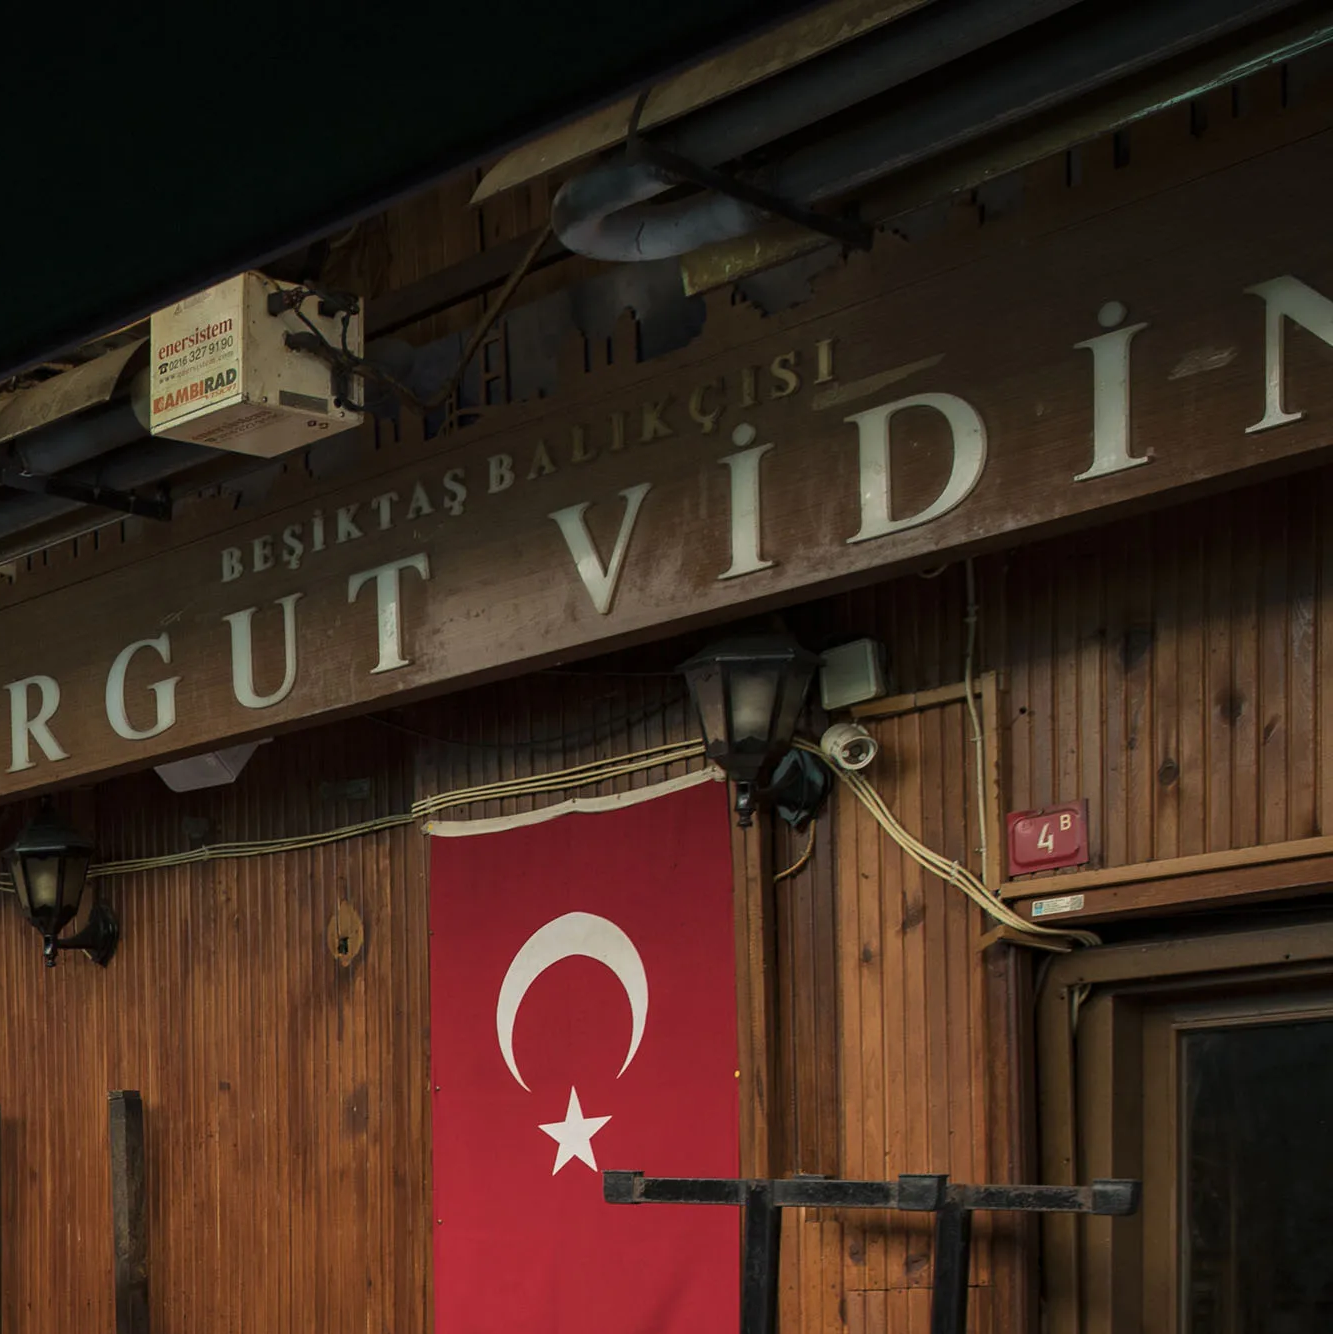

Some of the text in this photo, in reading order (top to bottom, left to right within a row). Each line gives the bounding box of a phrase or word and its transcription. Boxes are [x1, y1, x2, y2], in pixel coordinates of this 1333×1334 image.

[158, 318, 233, 360] enersistem
[221, 338, 837, 583] BEŞİKTAŞ BALIKÇISI
[1037, 813, 1072, 854] 4 B
